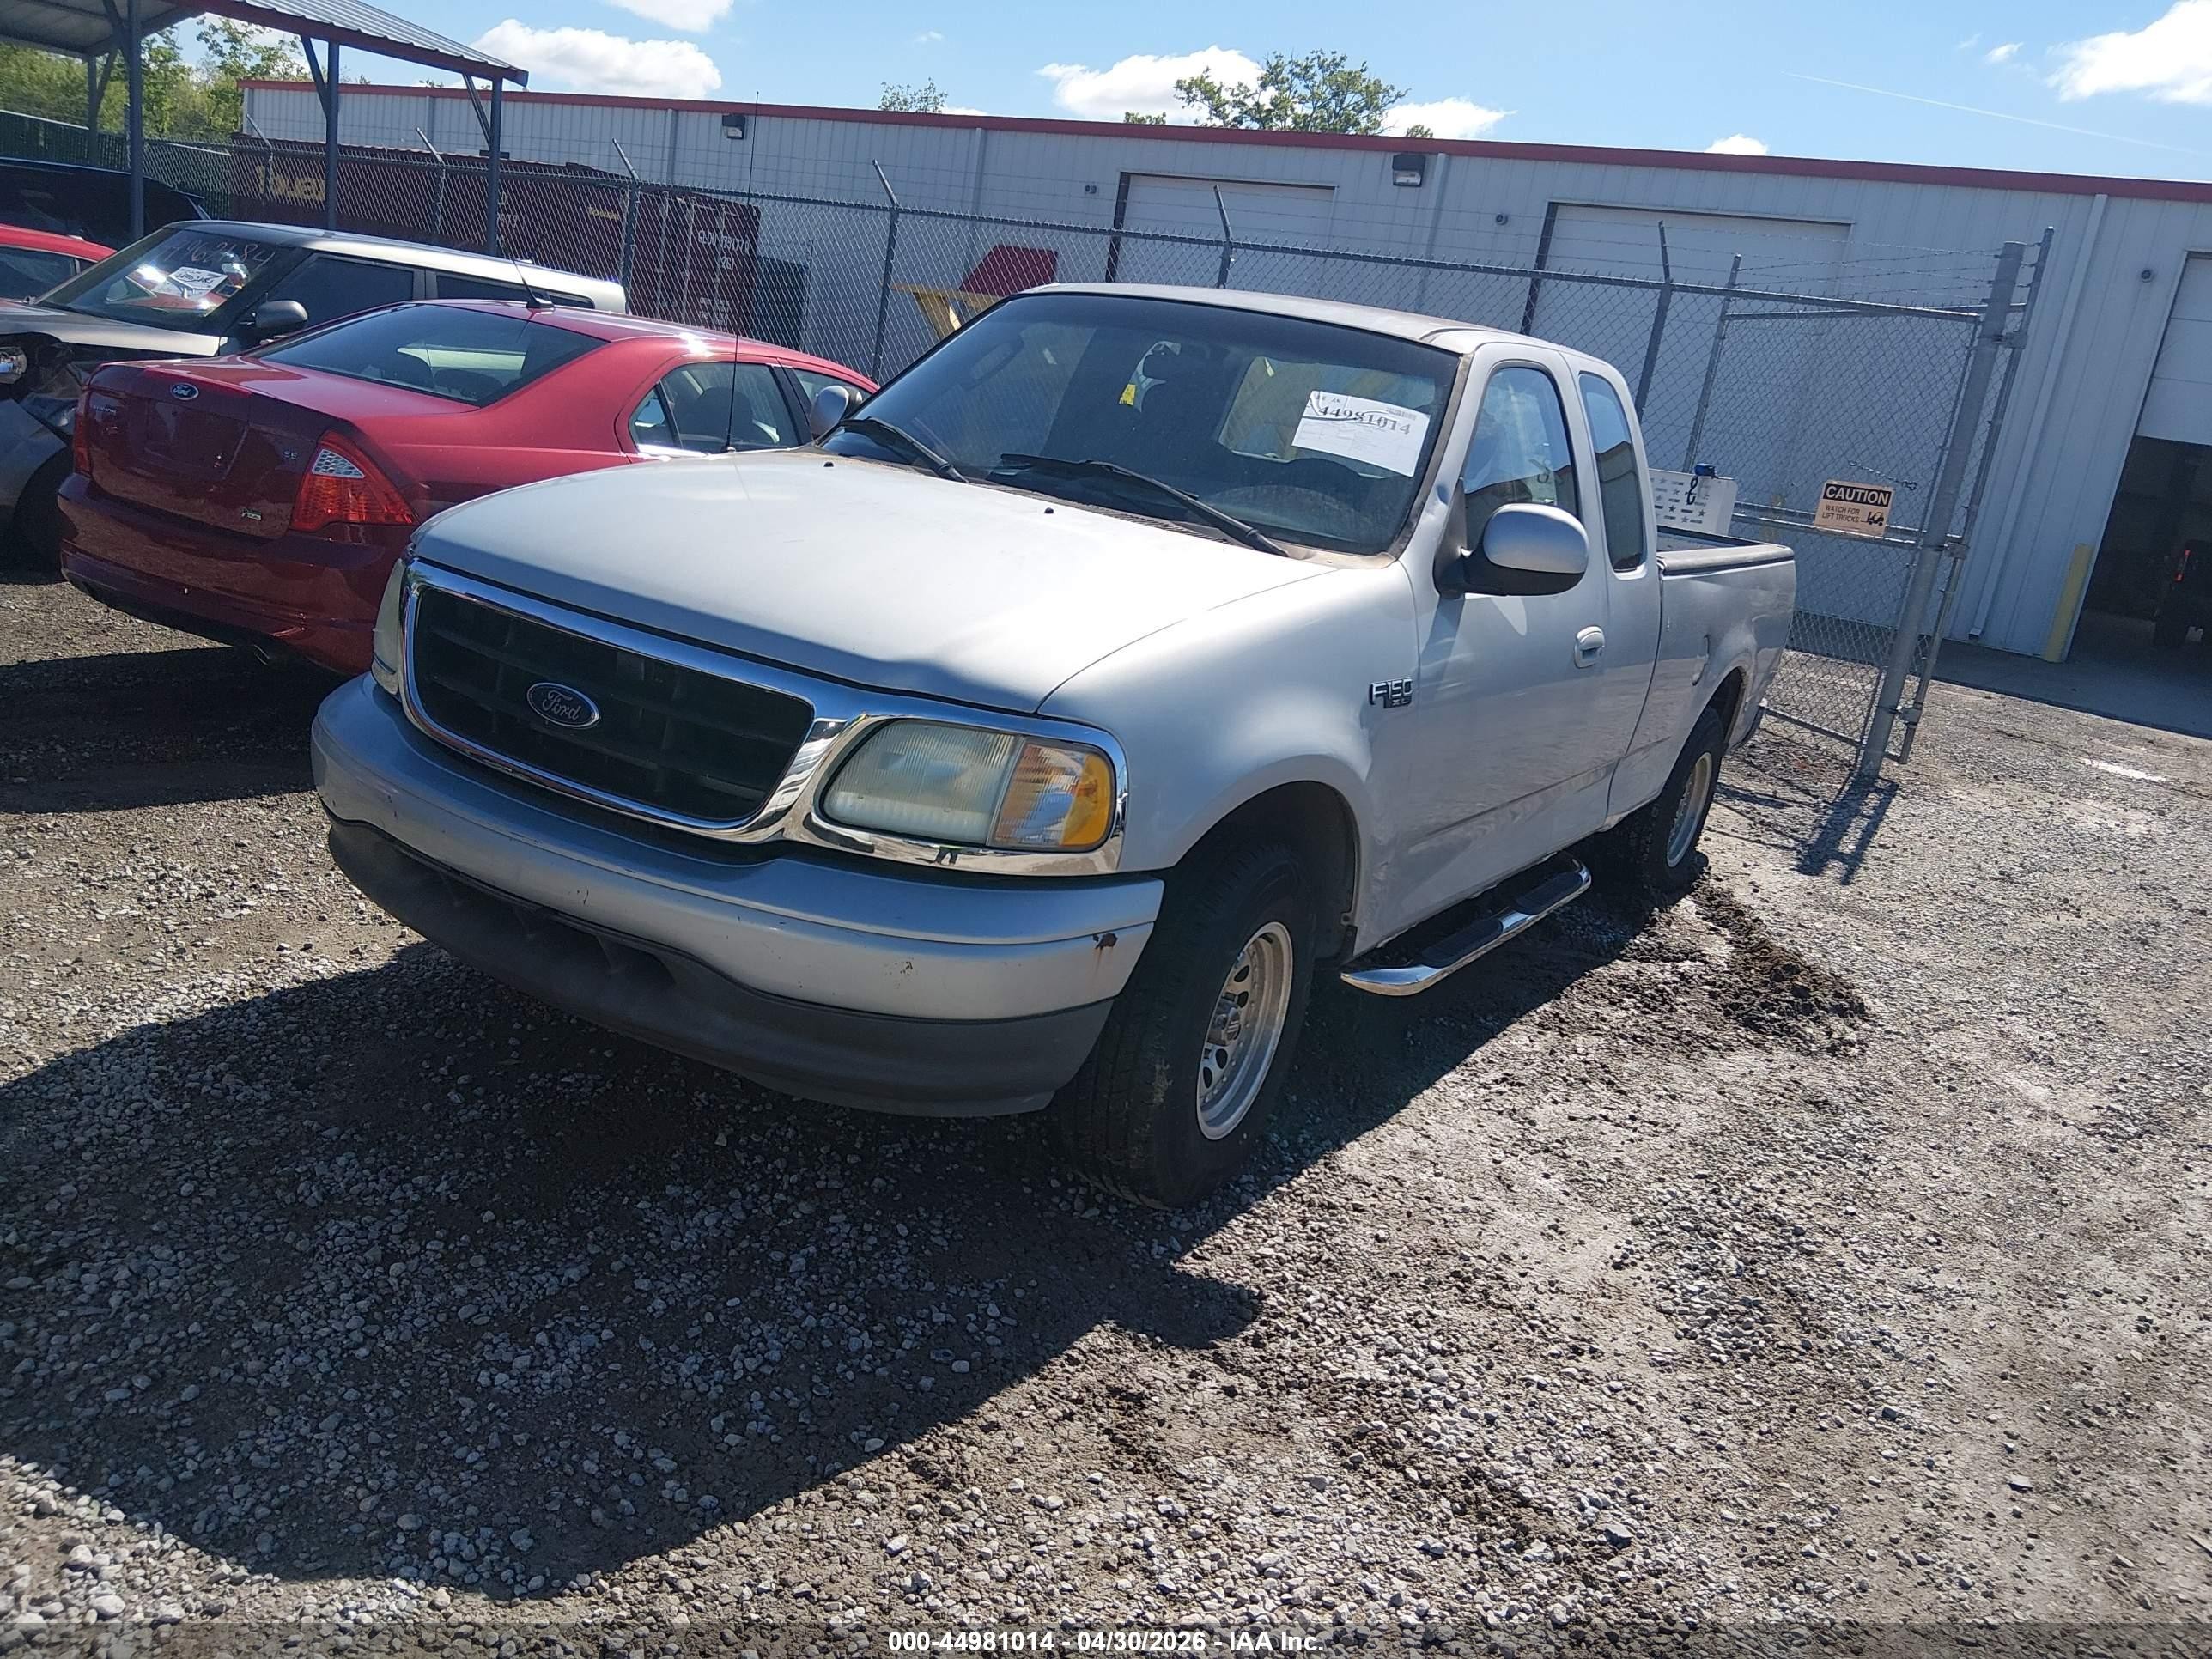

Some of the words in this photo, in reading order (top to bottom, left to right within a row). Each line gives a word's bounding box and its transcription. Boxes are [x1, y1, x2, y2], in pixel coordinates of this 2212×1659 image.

[1319, 406, 1412, 434] 44981014
[1826, 486, 1889, 506] CAUTION
[1826, 505, 1847, 514] WATCH
[1836, 514, 1860, 522] TRUCKS
[542, 690, 582, 720] Ford
